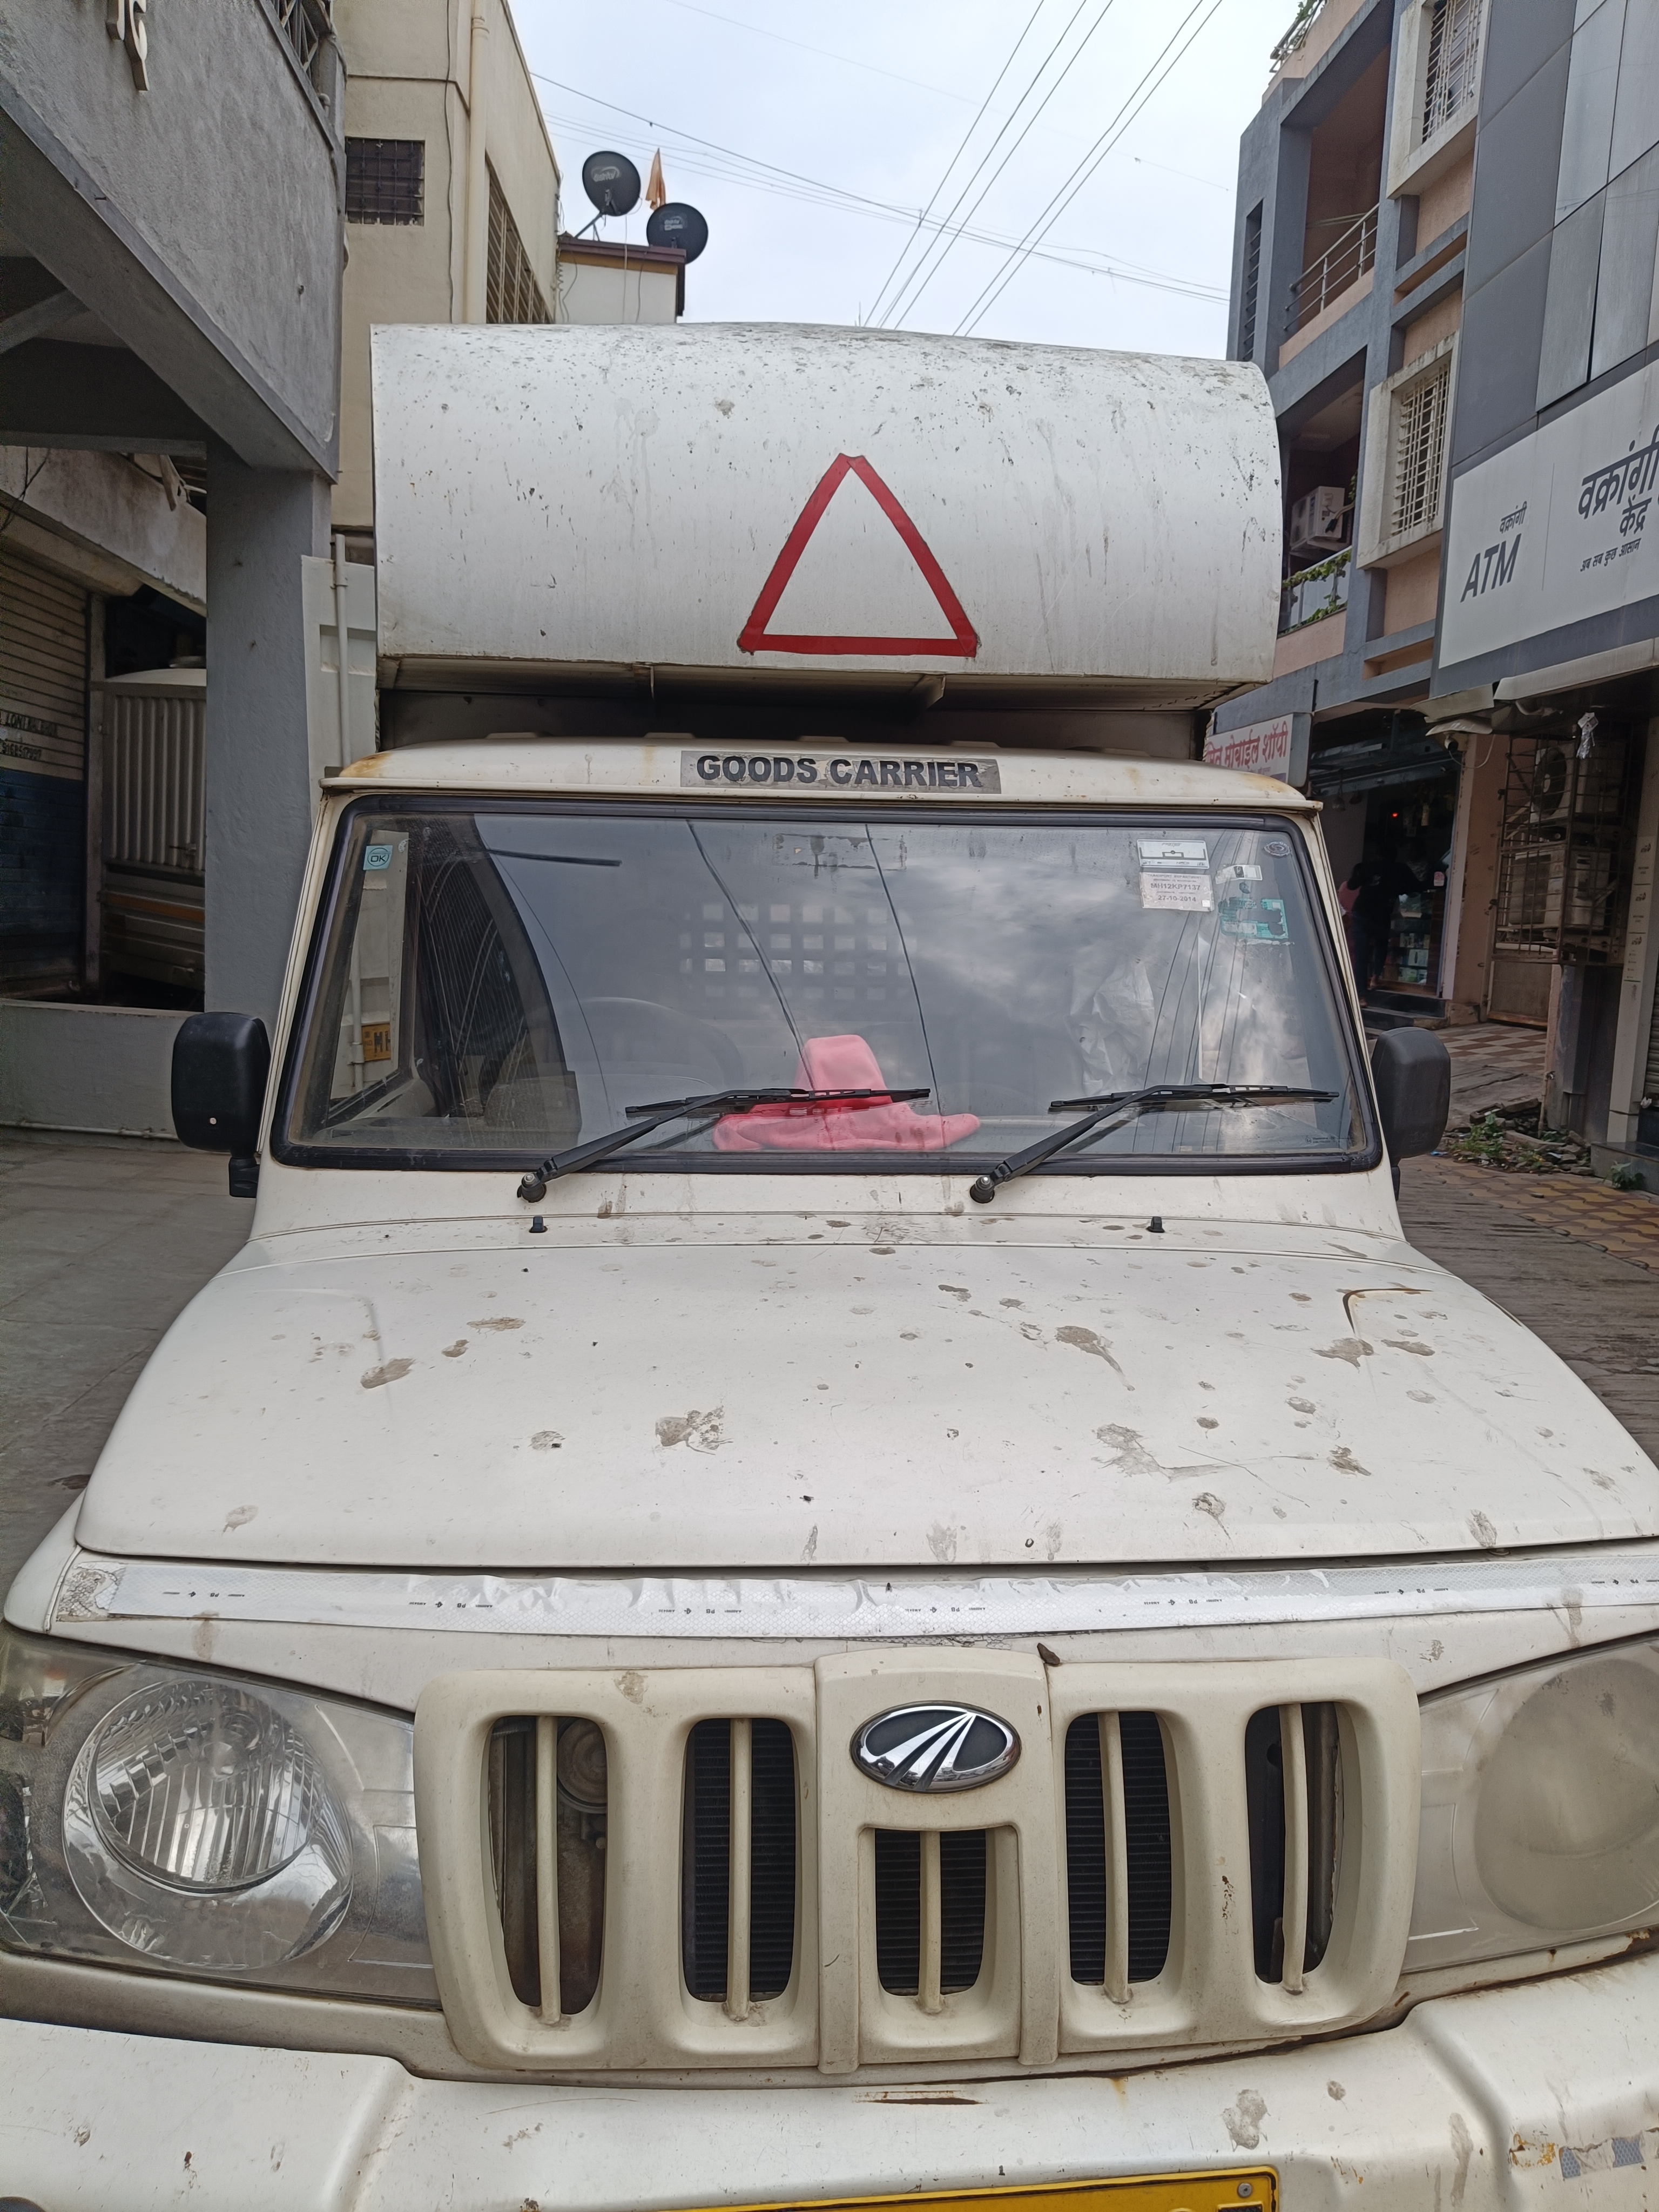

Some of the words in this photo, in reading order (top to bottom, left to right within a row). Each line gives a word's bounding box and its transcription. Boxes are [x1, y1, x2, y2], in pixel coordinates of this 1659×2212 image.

[1500, 501, 1527, 534] वक्रांगी
[1620, 494, 1652, 537] केंद्र
[1460, 534, 1521, 603] ATM
[1580, 557, 1592, 572] अब
[1593, 552, 1604, 567] सब
[1604, 547, 1618, 567] कुछ
[1619, 537, 1642, 557] आसान
[697, 754, 818, 784] GOODS
[830, 758, 983, 788] CARRIER
